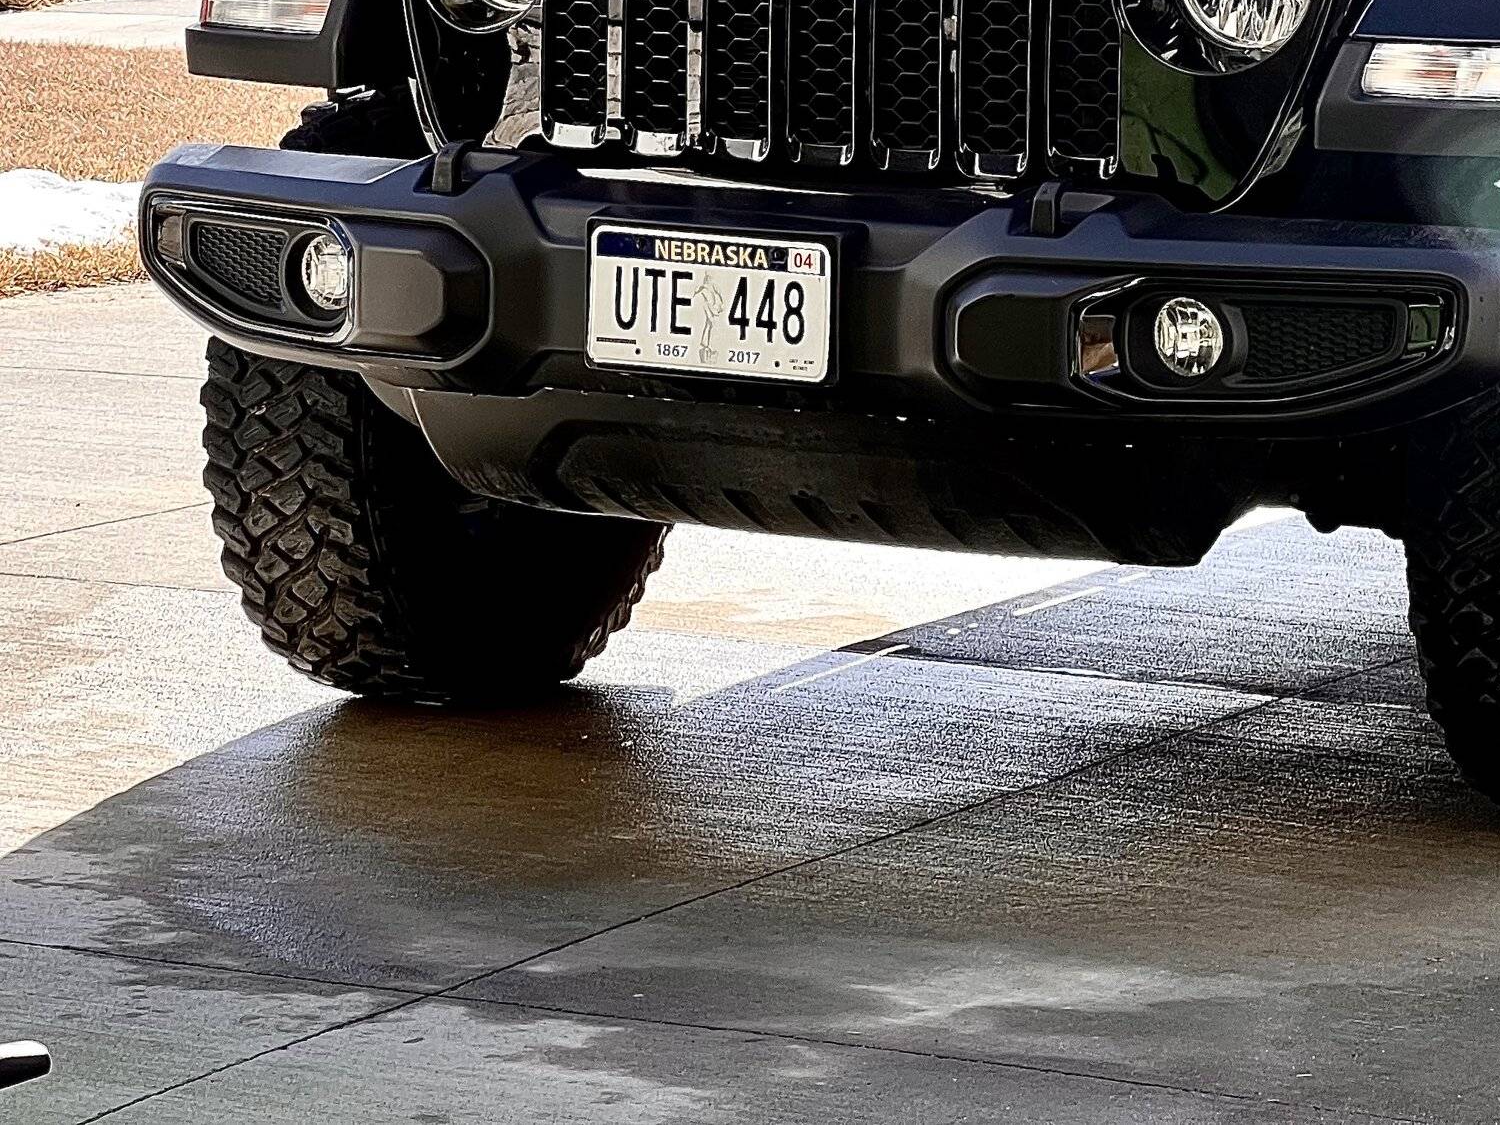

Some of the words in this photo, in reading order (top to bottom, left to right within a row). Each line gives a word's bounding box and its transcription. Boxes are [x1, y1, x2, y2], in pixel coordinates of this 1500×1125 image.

[653, 239, 769, 269] NEBRASKA
[793, 251, 814, 270] 04
[614, 265, 694, 336] UTE
[727, 276, 806, 345] 448
[656, 342, 689, 359] 1867
[727, 349, 761, 365] 2017
